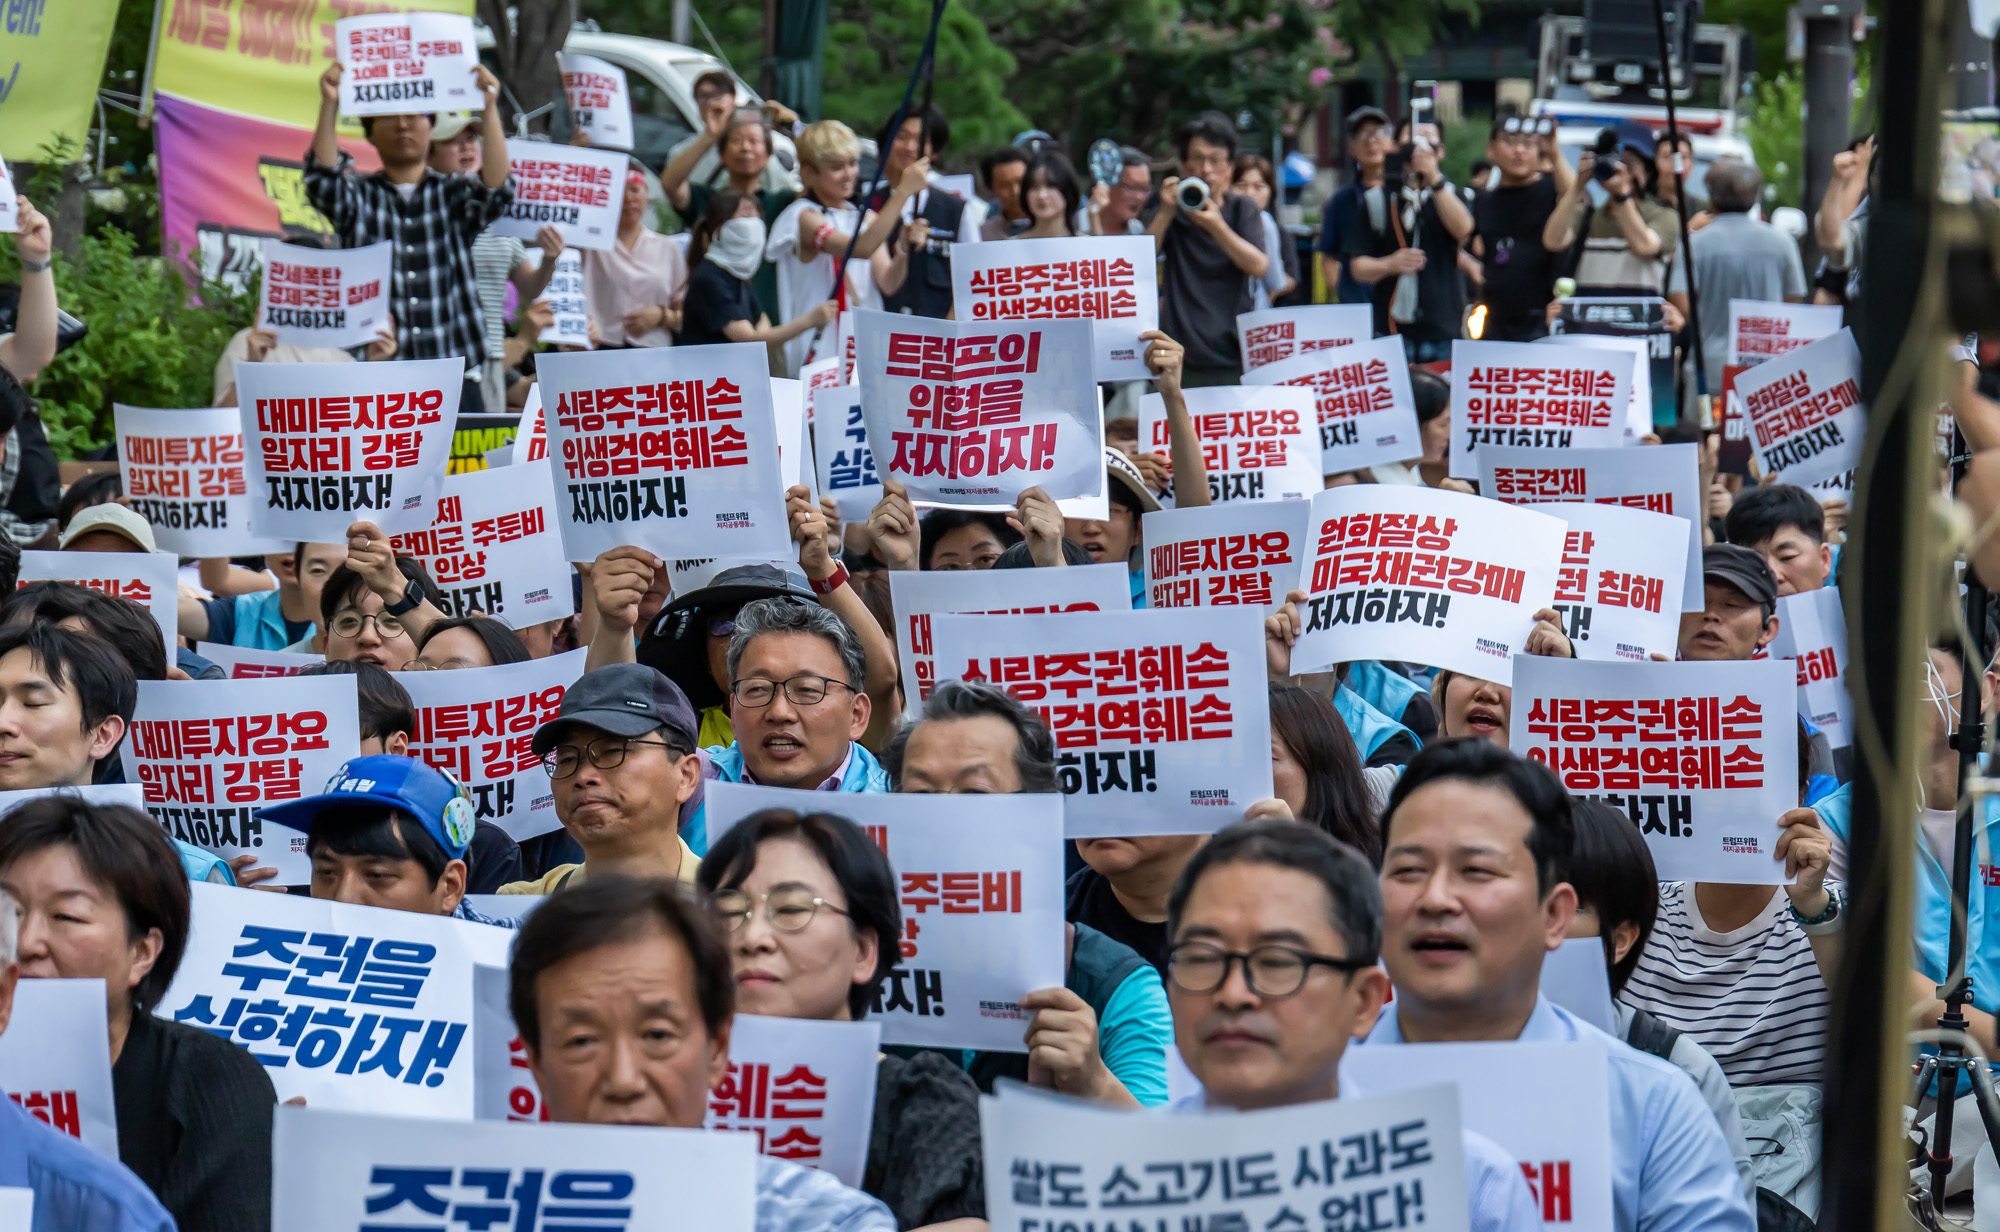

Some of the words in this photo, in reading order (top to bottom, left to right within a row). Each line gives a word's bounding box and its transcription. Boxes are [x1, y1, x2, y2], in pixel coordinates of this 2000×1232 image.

[353, 79, 434, 102] 저지하자!
[970, 257, 1135, 299] 식량주권훼손
[266, 306, 346, 329] 저지하자!
[886, 331, 1042, 382] 트럼프의
[1467, 367, 1616, 397] 식량주권훼손
[256, 389, 443, 434] 대미투자강요
[556, 377, 742, 433] 식량주권훼손
[906, 379, 1024, 431] 위협을
[1467, 397, 1612, 427] 위생검역훼손
[261, 437, 351, 472] 일자리
[361, 430, 422, 471] 강탈
[562, 424, 748, 479] 위생검역훼손
[889, 422, 1058, 480] 저지하자!
[1237, 440, 1287, 468] 강탈
[128, 469, 190, 497] 일자리
[266, 473, 392, 511] 저지하자!
[568, 475, 688, 524] 저지하자!
[1494, 467, 1587, 496] 중국견제
[471, 506, 545, 547] 주둔비
[1317, 513, 1457, 556] 원화절상
[434, 551, 487, 583] 인상
[1150, 531, 1292, 576] 대미투자강요
[1310, 551, 1526, 604] 미국채권강매
[1597, 570, 1664, 614] 침해
[1306, 588, 1451, 635] 저지하자!
[131, 711, 329, 760] 대미투자강요
[1030, 693, 1233, 749] 검역훼손
[1527, 695, 1763, 742] 식량주권훼손
[138, 764, 214, 804] 일자리
[223, 758, 303, 803] 강탈
[1722, 837, 1758, 846] 트럼프위협
[901, 870, 1022, 914] 주둔비
[221, 924, 438, 1009] 주권을
[1011, 1158, 1088, 1210] 쌀도
[1099, 1152, 1281, 1208] 소고기도
[1292, 1118, 1433, 1188] 사과도
